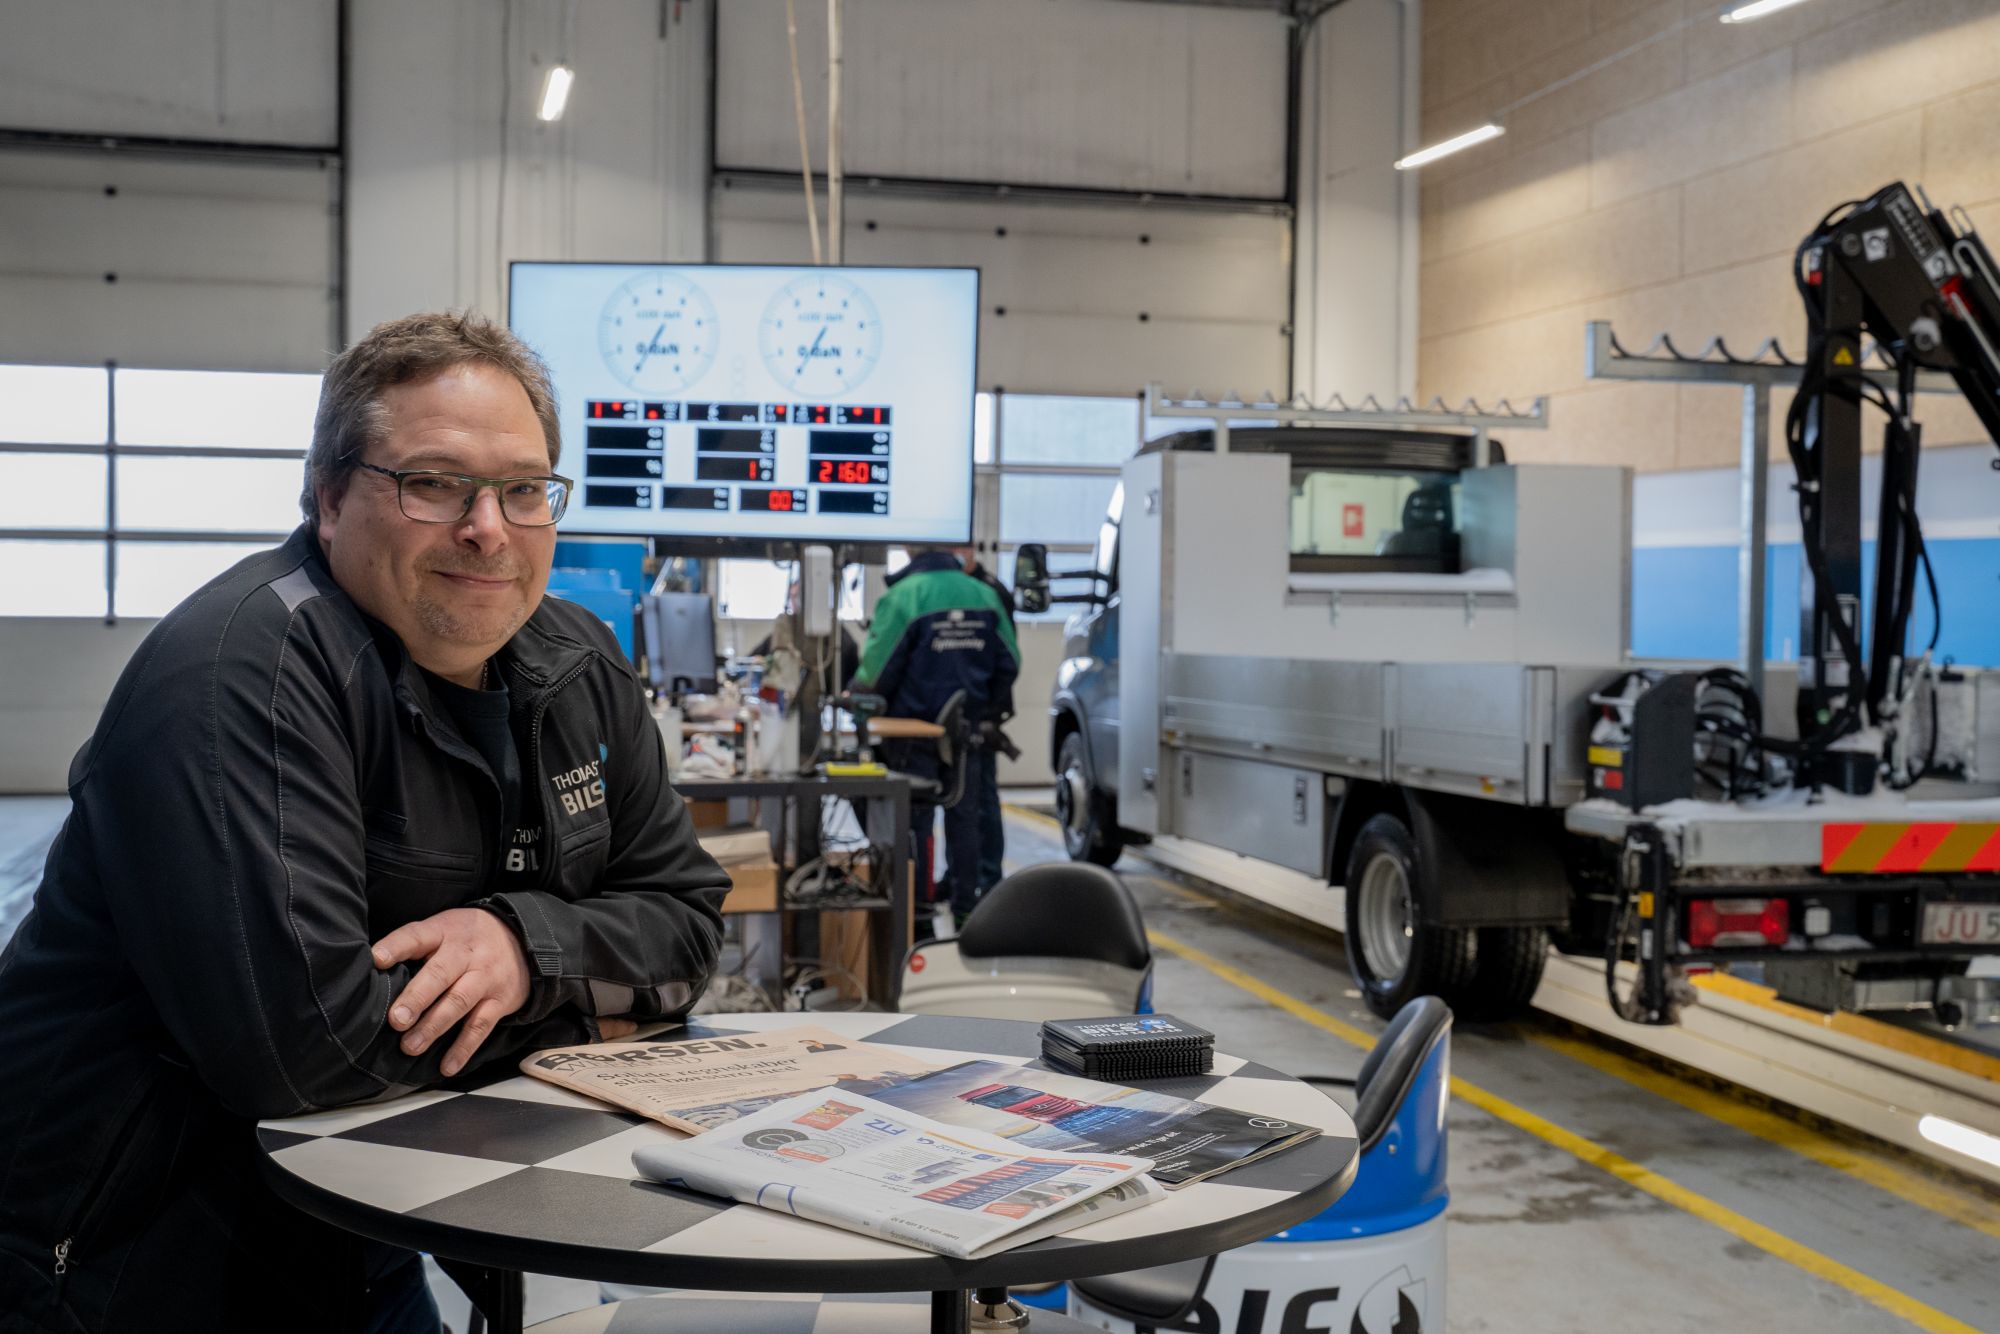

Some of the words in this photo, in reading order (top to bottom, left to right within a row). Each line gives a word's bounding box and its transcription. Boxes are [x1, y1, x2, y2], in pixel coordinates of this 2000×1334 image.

[818, 460, 870, 484] 2160
[1936, 911, 1980, 939] JU
[597, 1071, 671, 1081] Solide
[676, 1058, 798, 1076] regnskaber
[864, 1118, 907, 1136] FTZ
